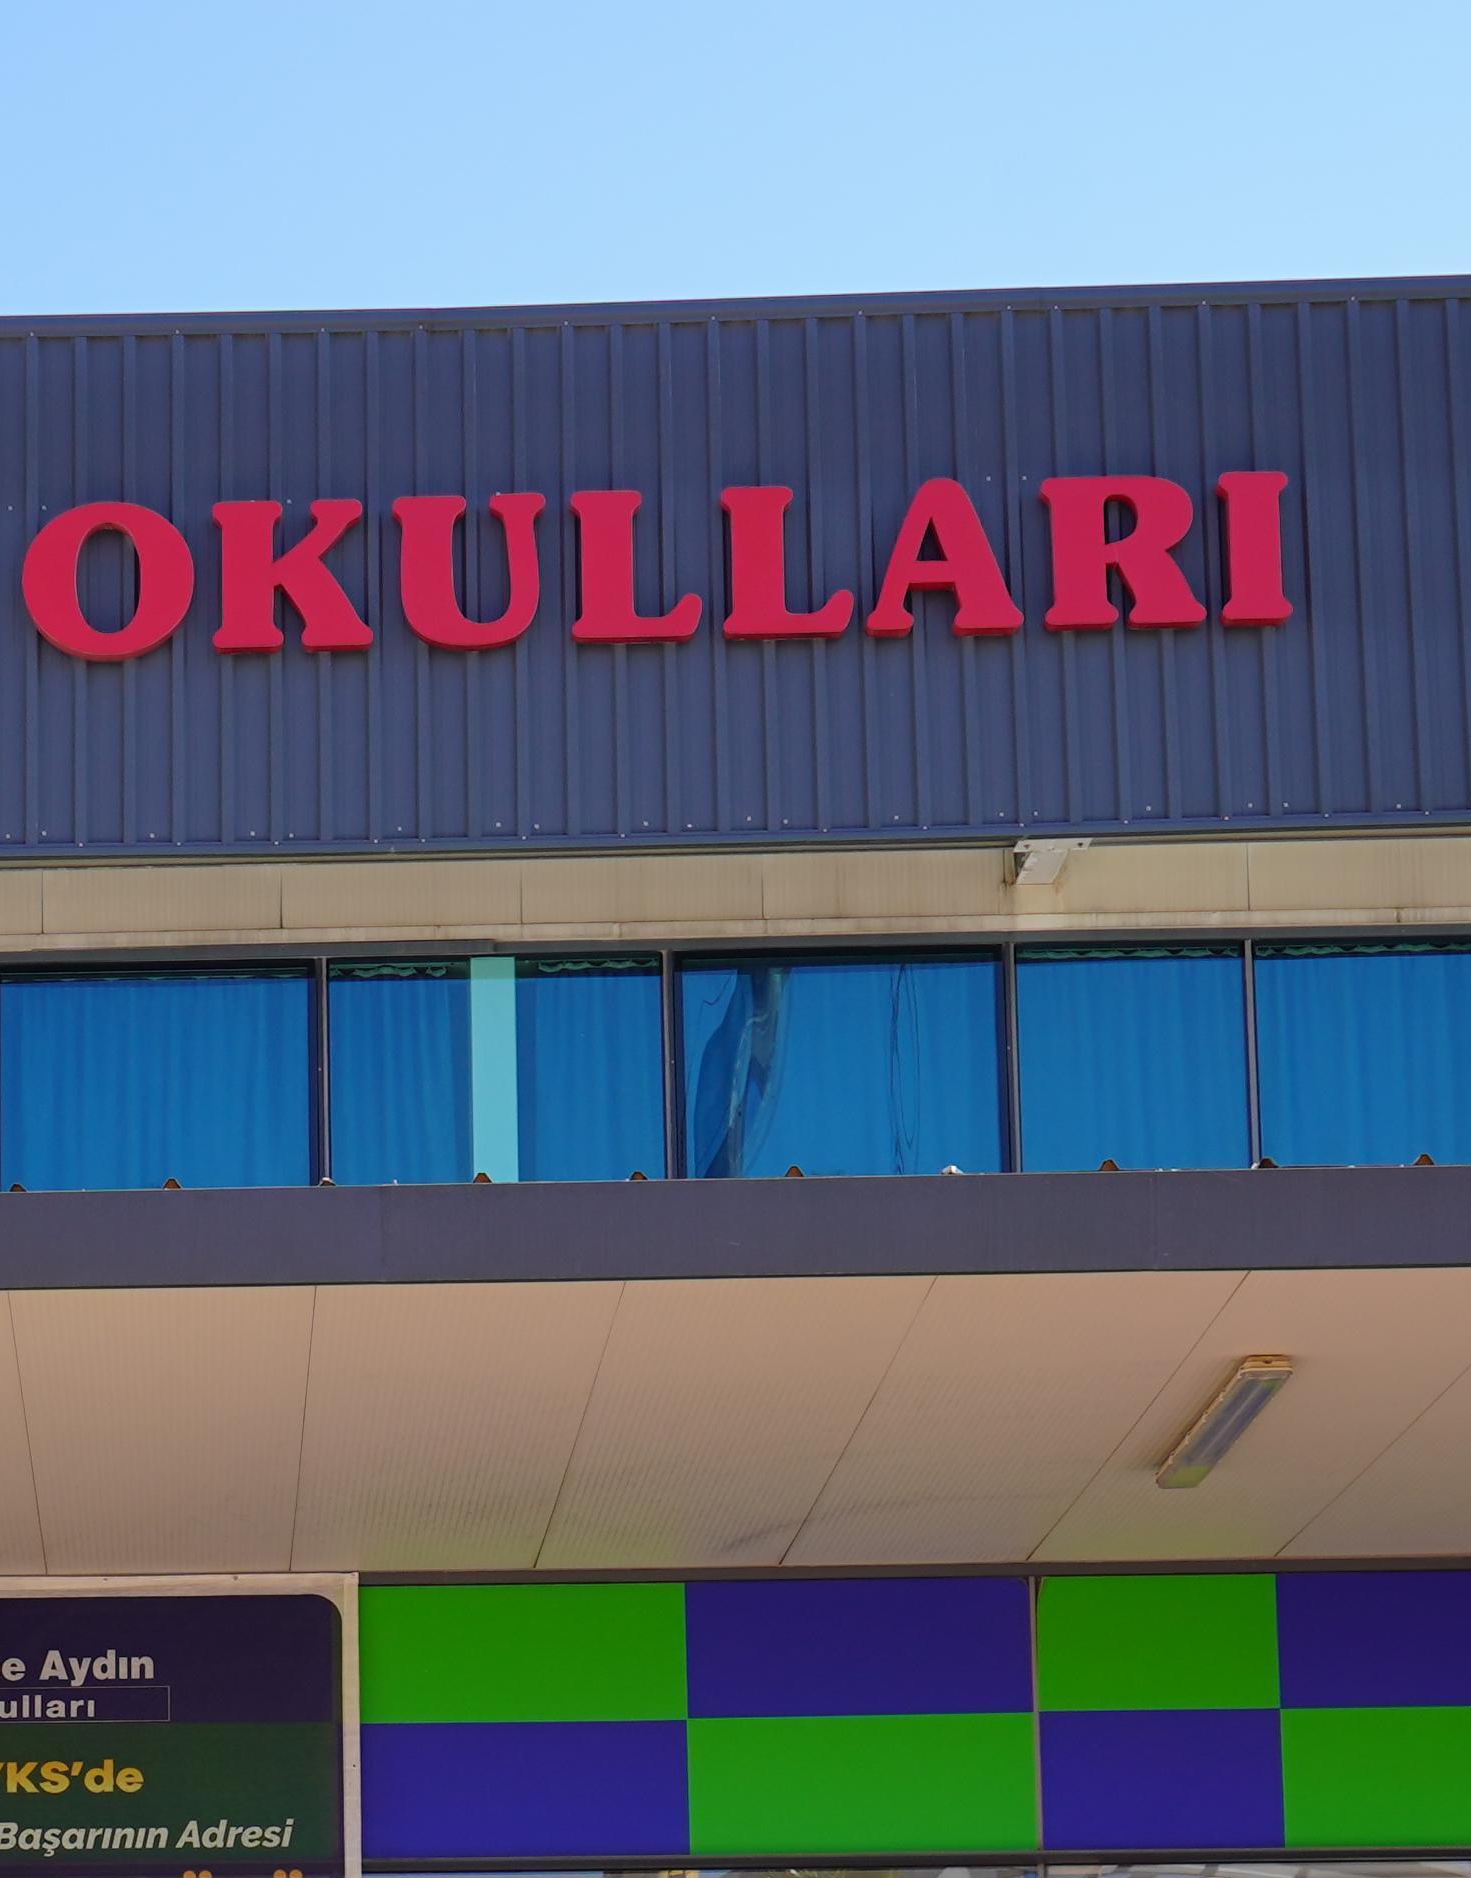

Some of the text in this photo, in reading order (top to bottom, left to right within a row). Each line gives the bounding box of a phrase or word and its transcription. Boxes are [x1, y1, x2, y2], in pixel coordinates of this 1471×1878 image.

[22, 470, 1295, 663] OKULLARI
[38, 1648, 155, 1687] Aydın
[175, 1817, 295, 1850] Adresi
